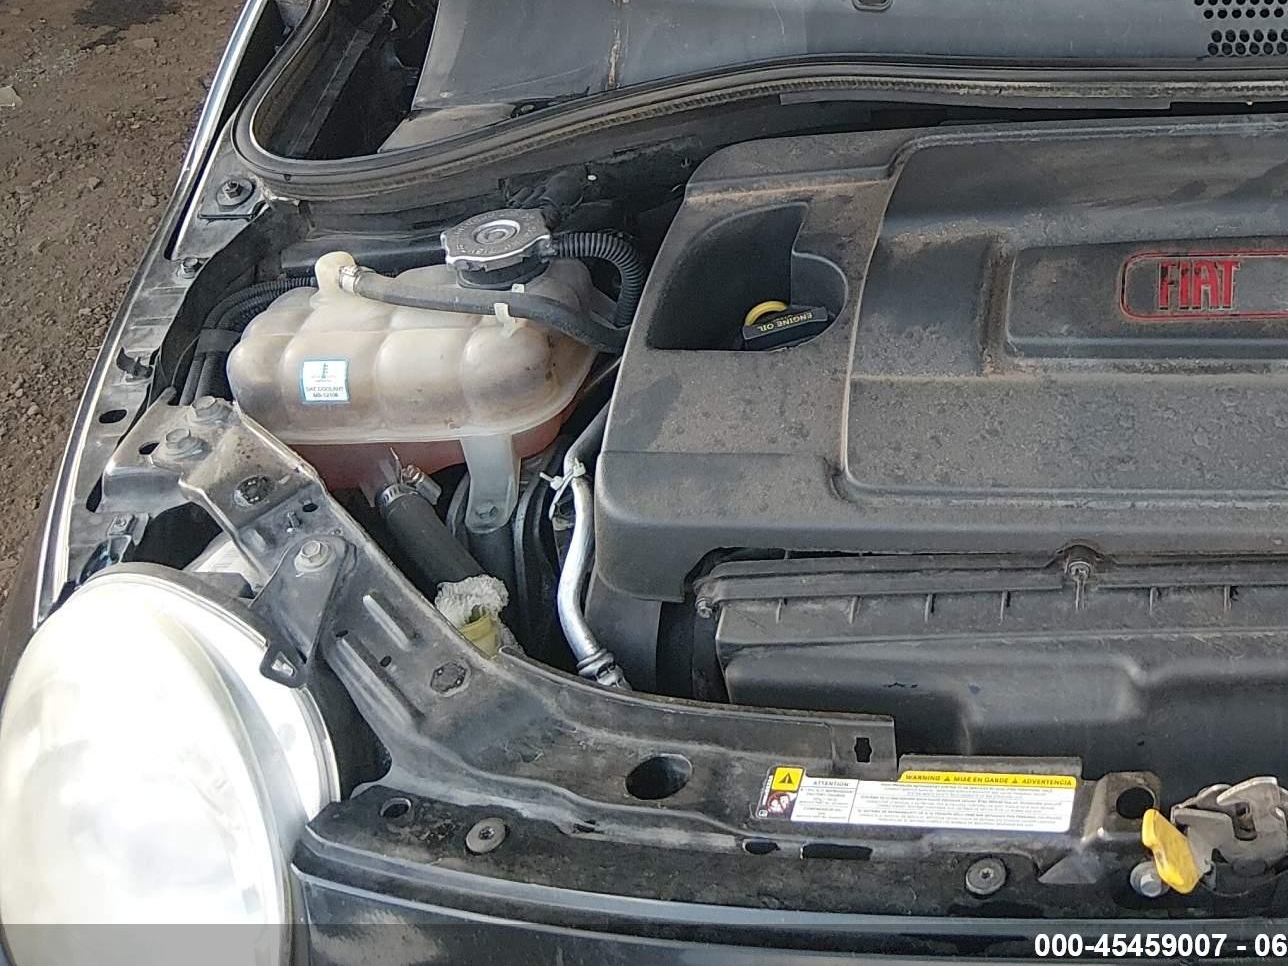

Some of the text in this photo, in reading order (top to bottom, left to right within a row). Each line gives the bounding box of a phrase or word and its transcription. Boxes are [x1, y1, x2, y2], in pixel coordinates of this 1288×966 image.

[1157, 259, 1241, 311] FIAT
[757, 312, 813, 332] ENGINE OIL
[905, 774, 942, 782] WARNING
[973, 776, 983, 784] EN
[1022, 778, 1073, 786] ADVERTENCIA
